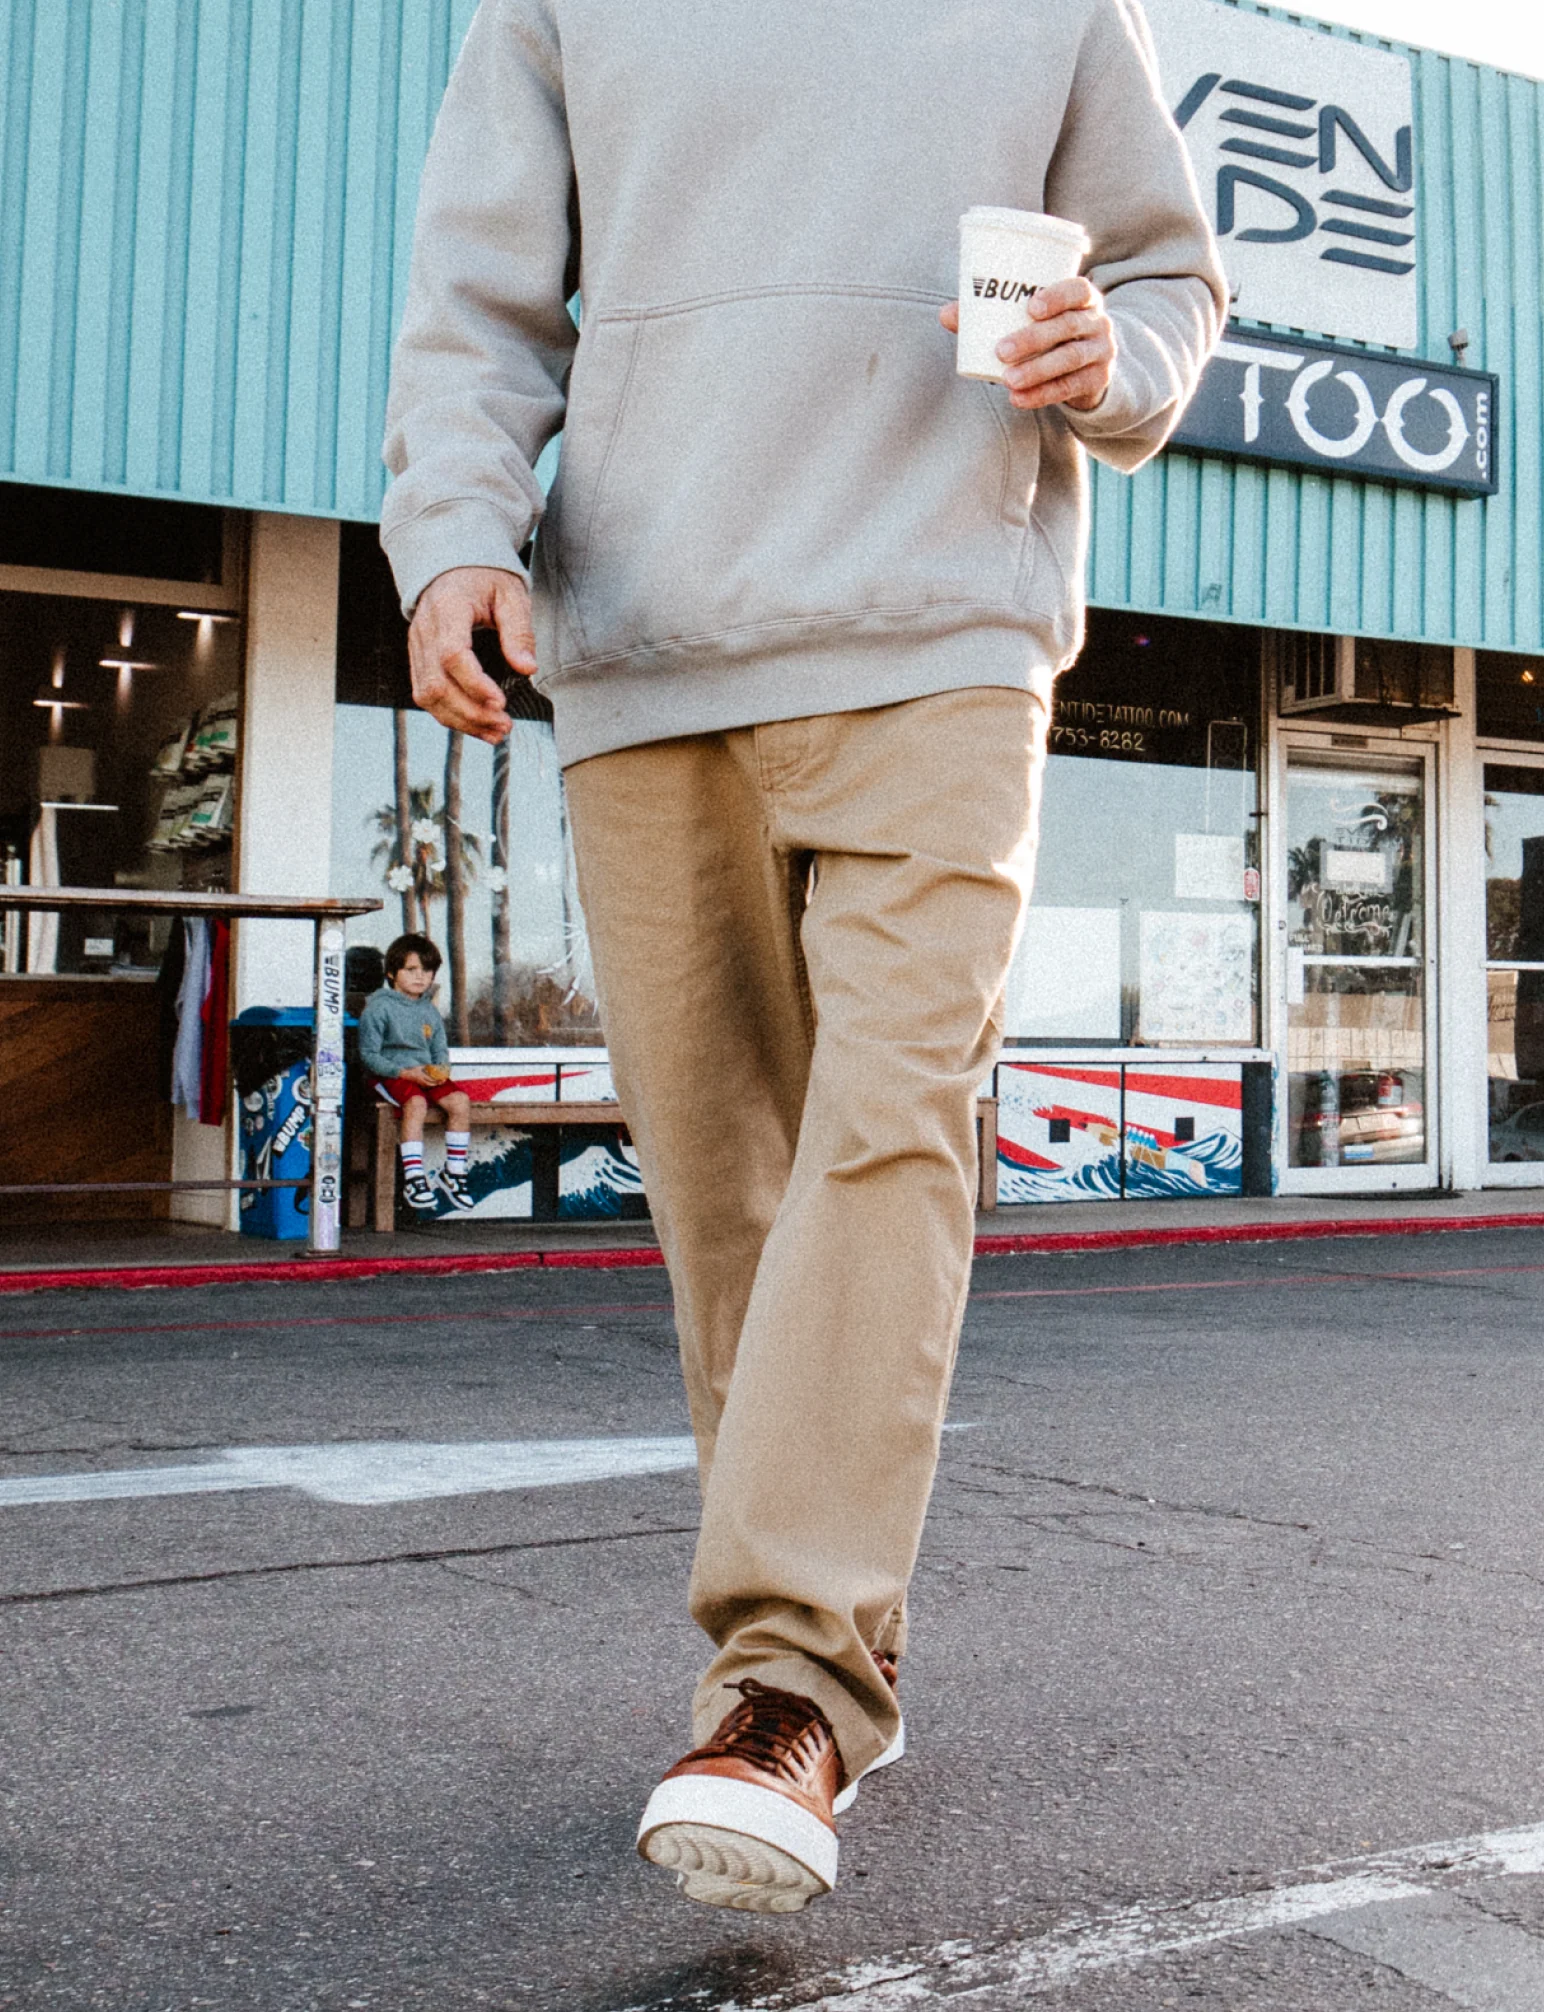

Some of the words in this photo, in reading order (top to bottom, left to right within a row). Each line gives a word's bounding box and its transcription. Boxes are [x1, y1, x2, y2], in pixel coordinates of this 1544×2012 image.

[984, 278, 1045, 302] BUM
[1476, 392, 1488, 479] .com
[324, 966, 340, 1015] BUMP
[275, 1104, 306, 1148] BUMP
